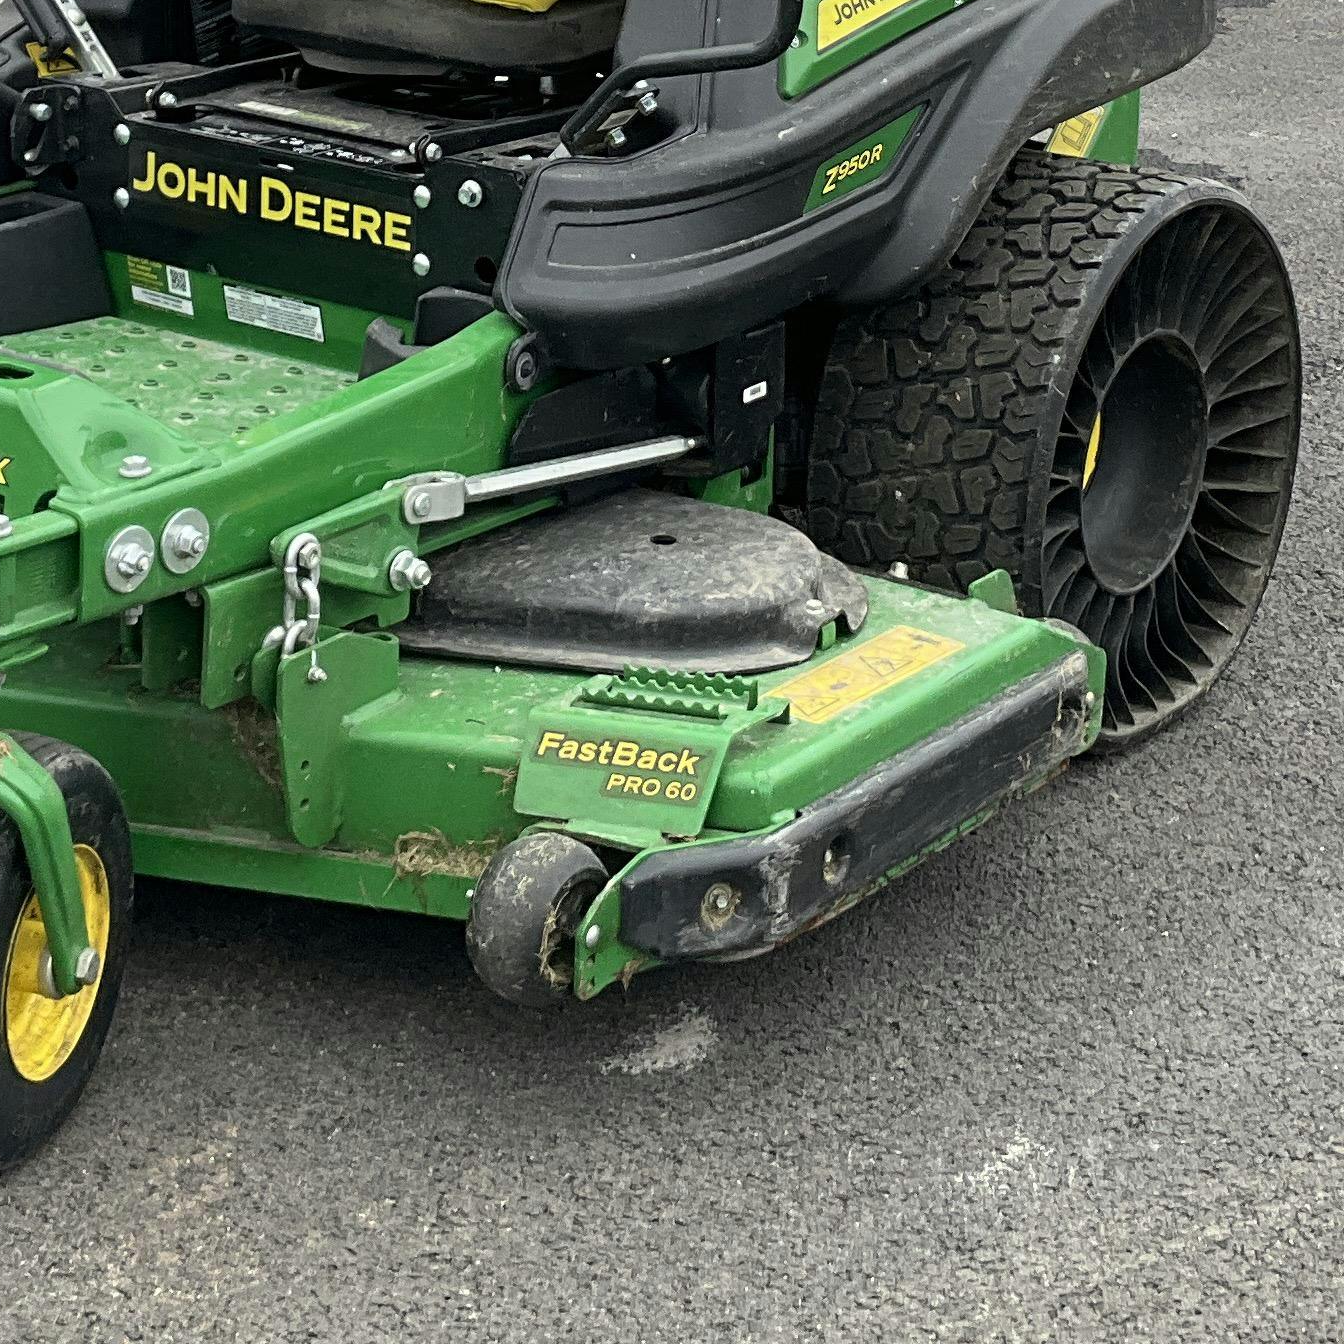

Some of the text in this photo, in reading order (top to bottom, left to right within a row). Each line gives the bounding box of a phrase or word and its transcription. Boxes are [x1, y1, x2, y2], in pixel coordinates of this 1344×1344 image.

[822, 143, 883, 195] Z950R
[133, 151, 412, 252] JOHN DEERE
[537, 731, 700, 775] FastBack
[606, 773, 697, 801] PRO 60
